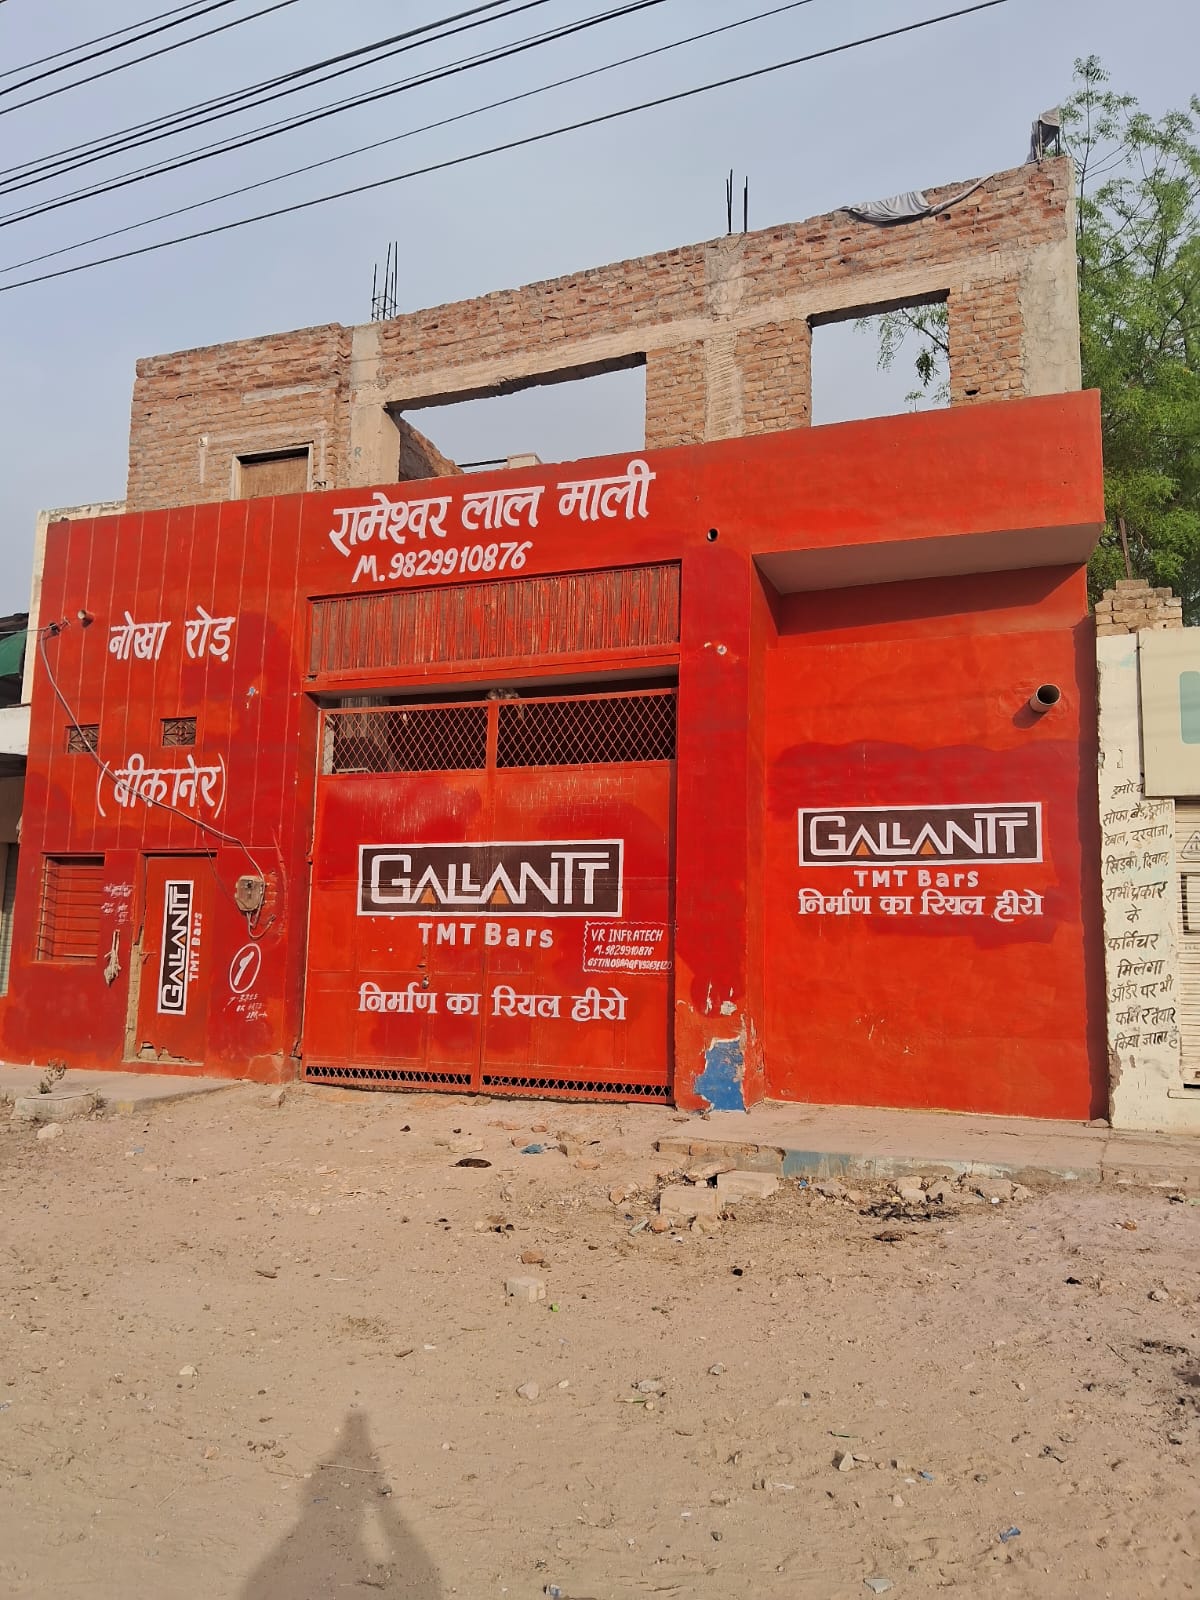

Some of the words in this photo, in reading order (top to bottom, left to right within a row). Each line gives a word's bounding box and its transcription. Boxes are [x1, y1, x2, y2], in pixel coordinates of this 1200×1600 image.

[328, 492, 452, 556] रामेश्वर
[461, 485, 545, 530] लाल
[556, 459, 657, 521] माली
[109, 611, 171, 660] नोखा
[185, 605, 236, 662] रोड़
[97, 753, 226, 819] (बीकानेर)
[809, 812, 1028, 856] GALLANTT
[371, 852, 609, 905] GALLANTT
[854, 870, 908, 888] TMT
[917, 869, 979, 888] Bars
[798, 887, 872, 915] निर्माण
[879, 895, 914, 915] का
[919, 888, 986, 915] रियल
[990, 889, 1045, 922] हीरो
[1125, 903, 1142, 923] के
[162, 885, 189, 1007] GALLANTT
[191, 912, 203, 946] Bars
[418, 923, 476, 945] TMT
[485, 923, 554, 948] Bars
[591, 928, 606, 942] VR
[608, 929, 664, 943] INFRATECH
[189, 950, 200, 983] TMT
[358, 981, 438, 1014] निर्माण
[445, 992, 481, 1016] का
[491, 985, 562, 1018] रियल
[570, 987, 629, 1022] हीरो
[1140, 983, 1158, 998] पर
